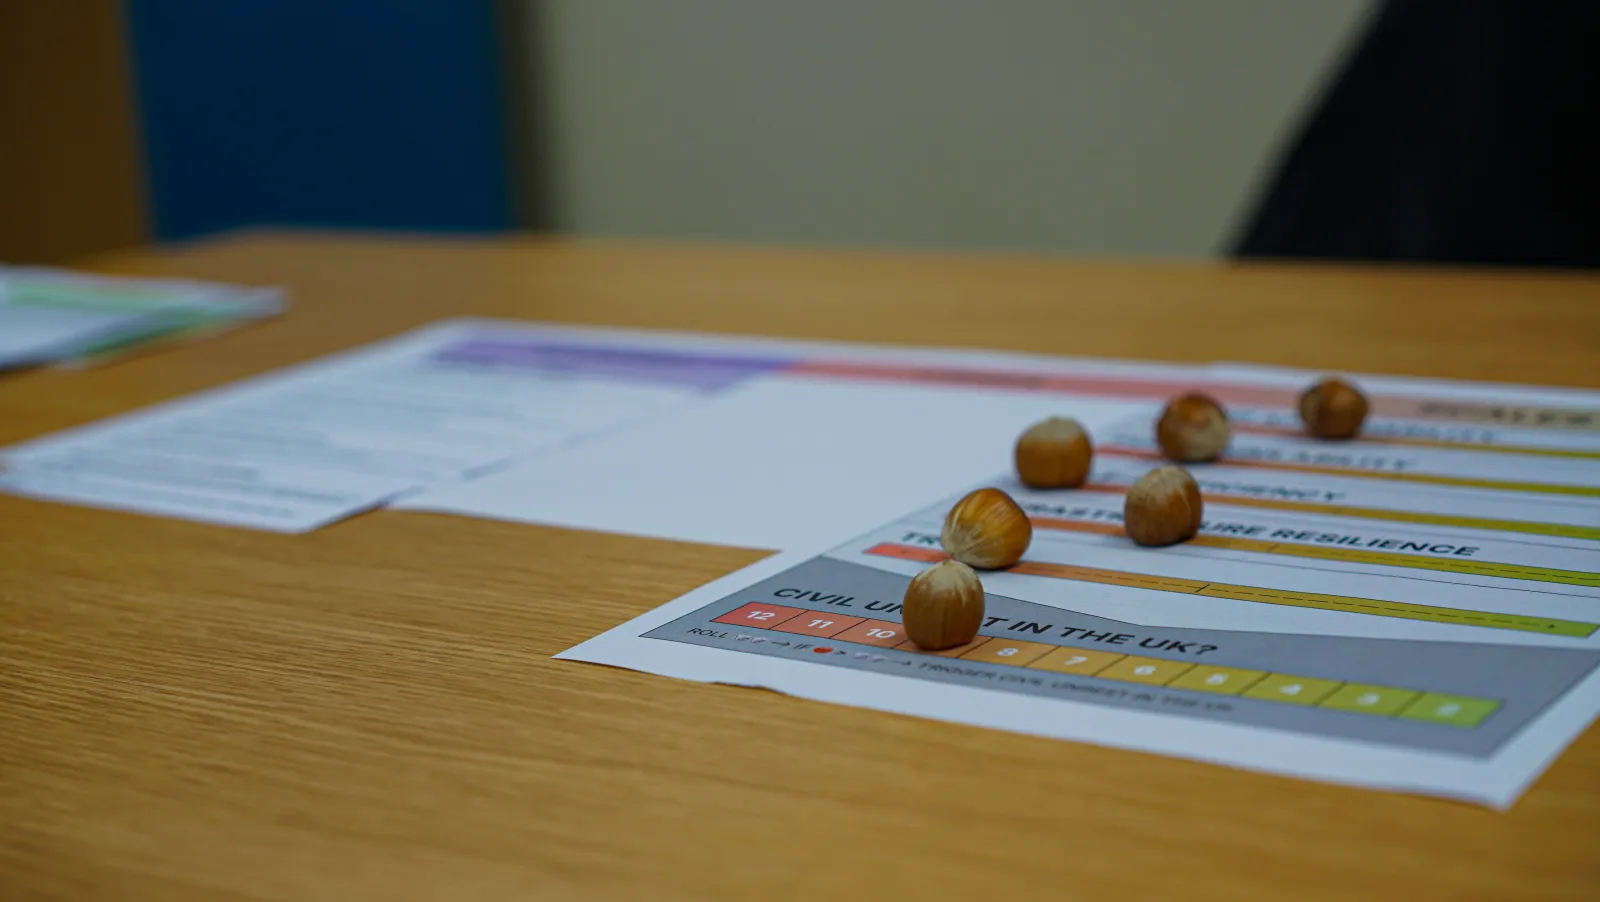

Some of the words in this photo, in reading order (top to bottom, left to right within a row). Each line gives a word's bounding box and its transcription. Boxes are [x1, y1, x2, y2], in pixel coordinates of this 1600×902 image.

[1270, 527, 1481, 557] RESILIENCE
[687, 627, 728, 639] ROLL
[746, 610, 775, 621] 12
[807, 619, 834, 629] 11
[865, 628, 896, 639] 10
[996, 647, 1019, 657] 8
[1064, 656, 1088, 666] 7
[773, 588, 855, 607] CIVIL
[864, 600, 1009, 628] UNT
[1008, 620, 1054, 634] IN
[1060, 626, 1135, 645] THE
[1138, 637, 1219, 656] UK?
